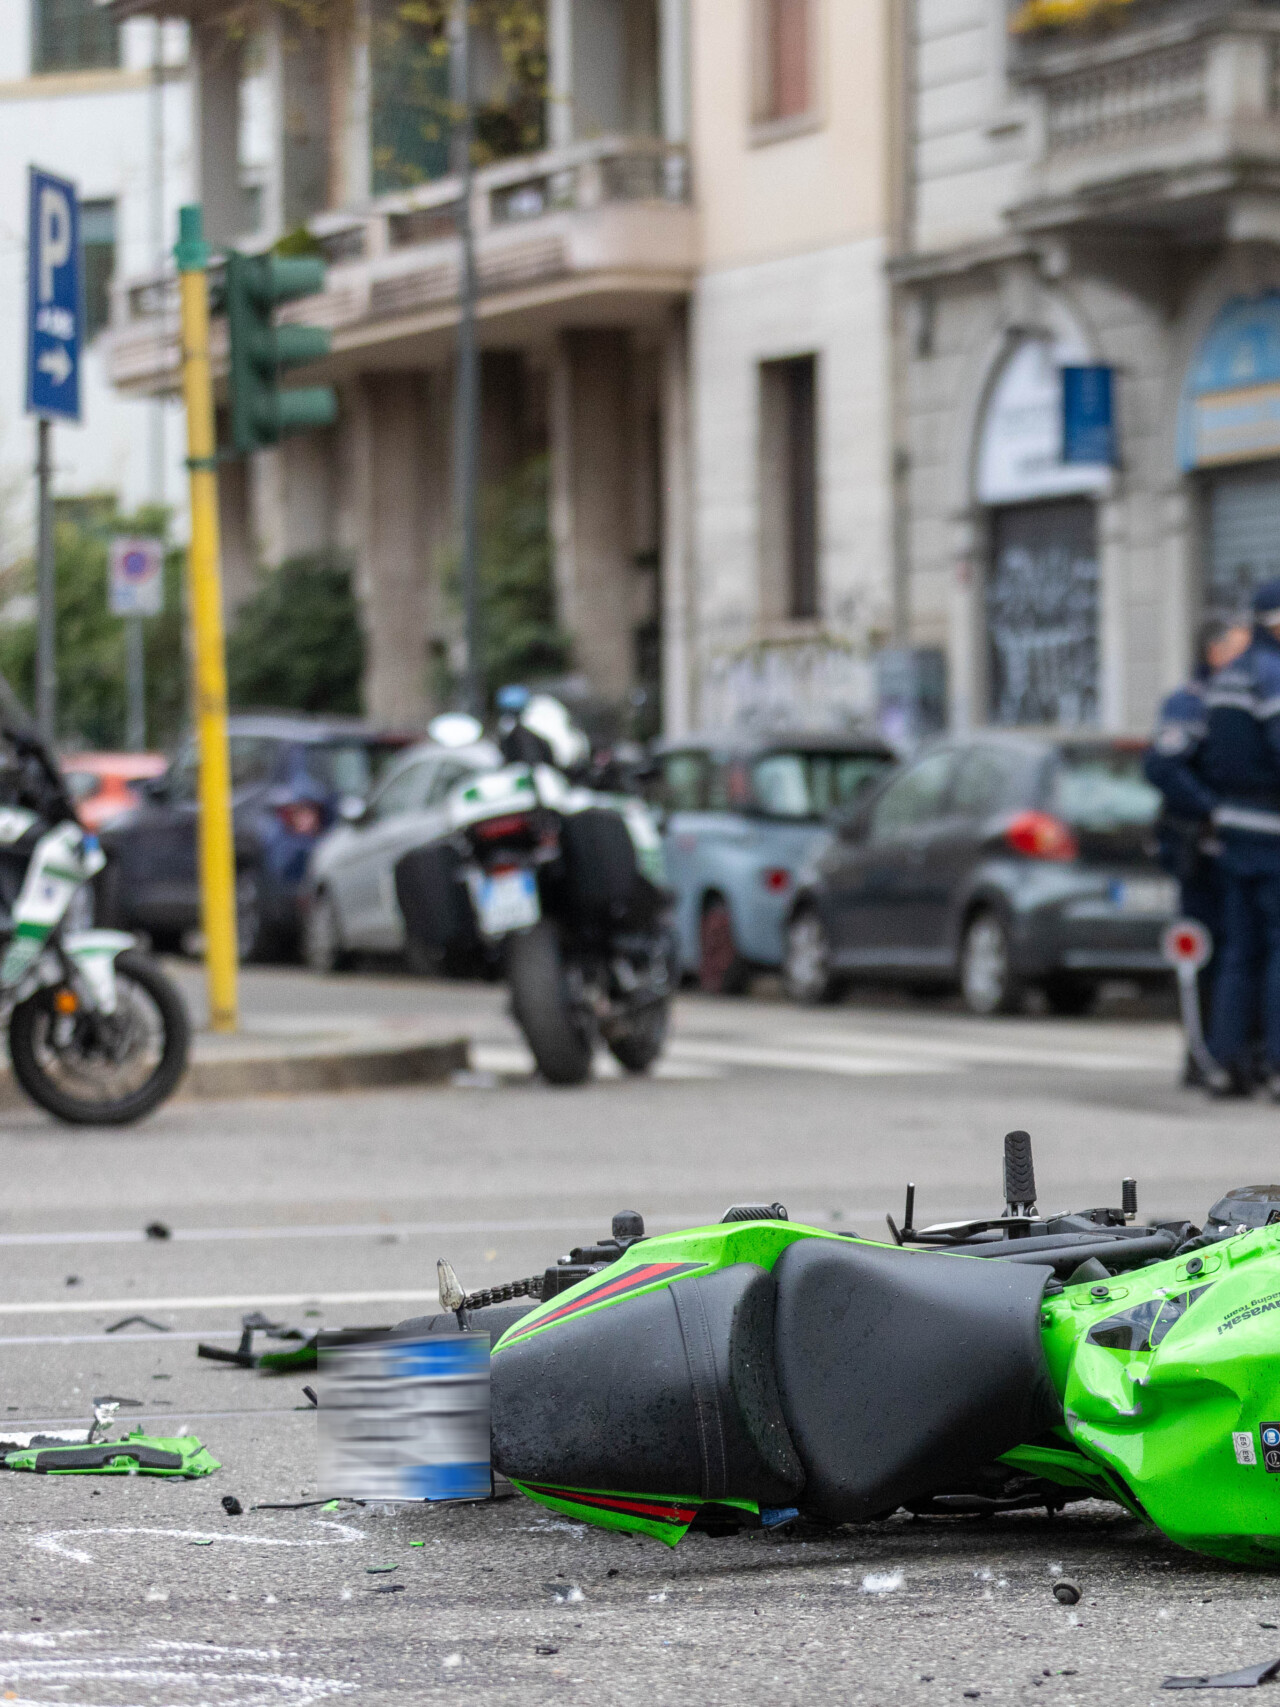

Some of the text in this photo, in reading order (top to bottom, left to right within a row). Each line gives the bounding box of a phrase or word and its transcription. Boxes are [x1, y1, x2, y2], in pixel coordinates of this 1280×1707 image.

[38, 186, 72, 305] P
[1223, 1303, 1251, 1321] Team
[1239, 1436, 1251, 1463] E5 E10
